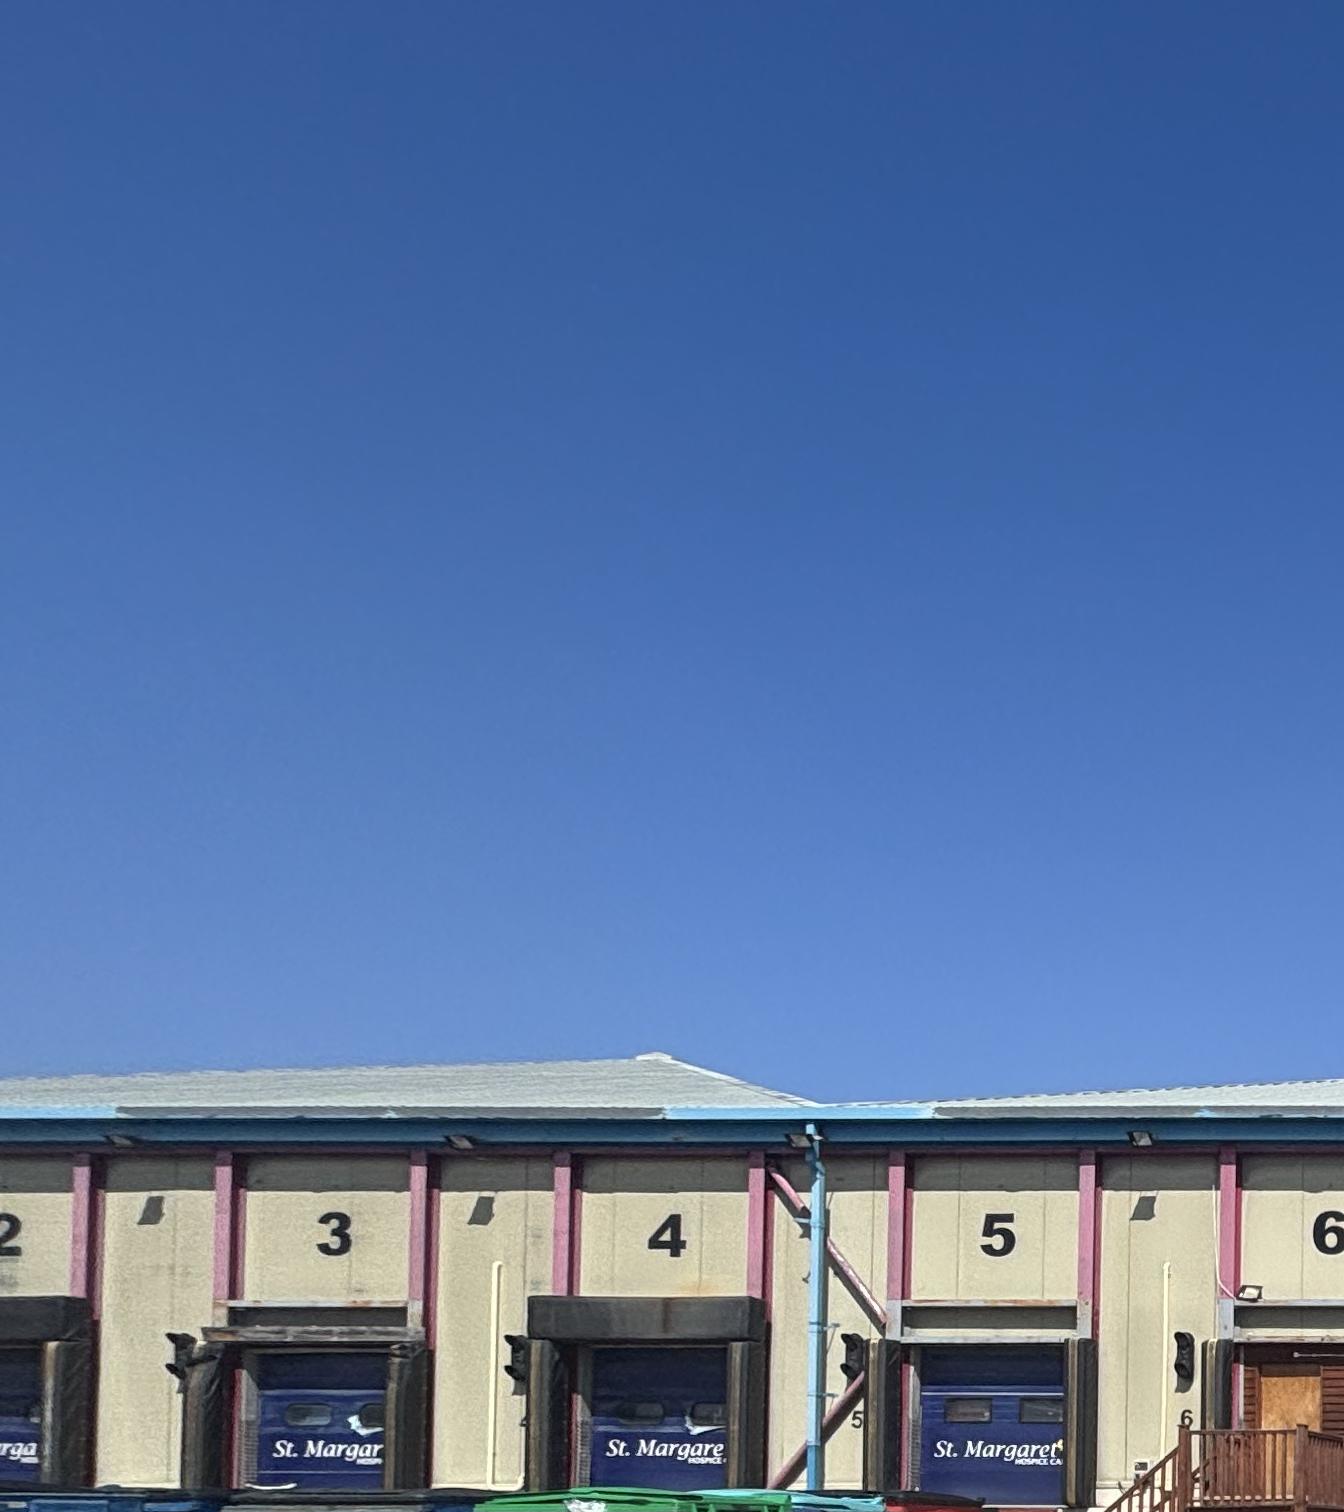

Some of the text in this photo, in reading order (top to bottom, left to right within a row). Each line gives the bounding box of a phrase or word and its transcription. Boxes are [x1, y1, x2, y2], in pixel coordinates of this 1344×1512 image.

[0, 1212, 22, 1257] 2
[316, 1211, 352, 1257] 3
[647, 1213, 687, 1258] 4
[980, 1213, 1016, 1257] 5
[851, 1410, 863, 1429] 5
[1181, 1409, 1193, 1427] 6
[272, 1439, 384, 1462] St. Margar
[605, 1439, 725, 1461] St. Margare
[933, 1440, 1058, 1462] St. Margaret
